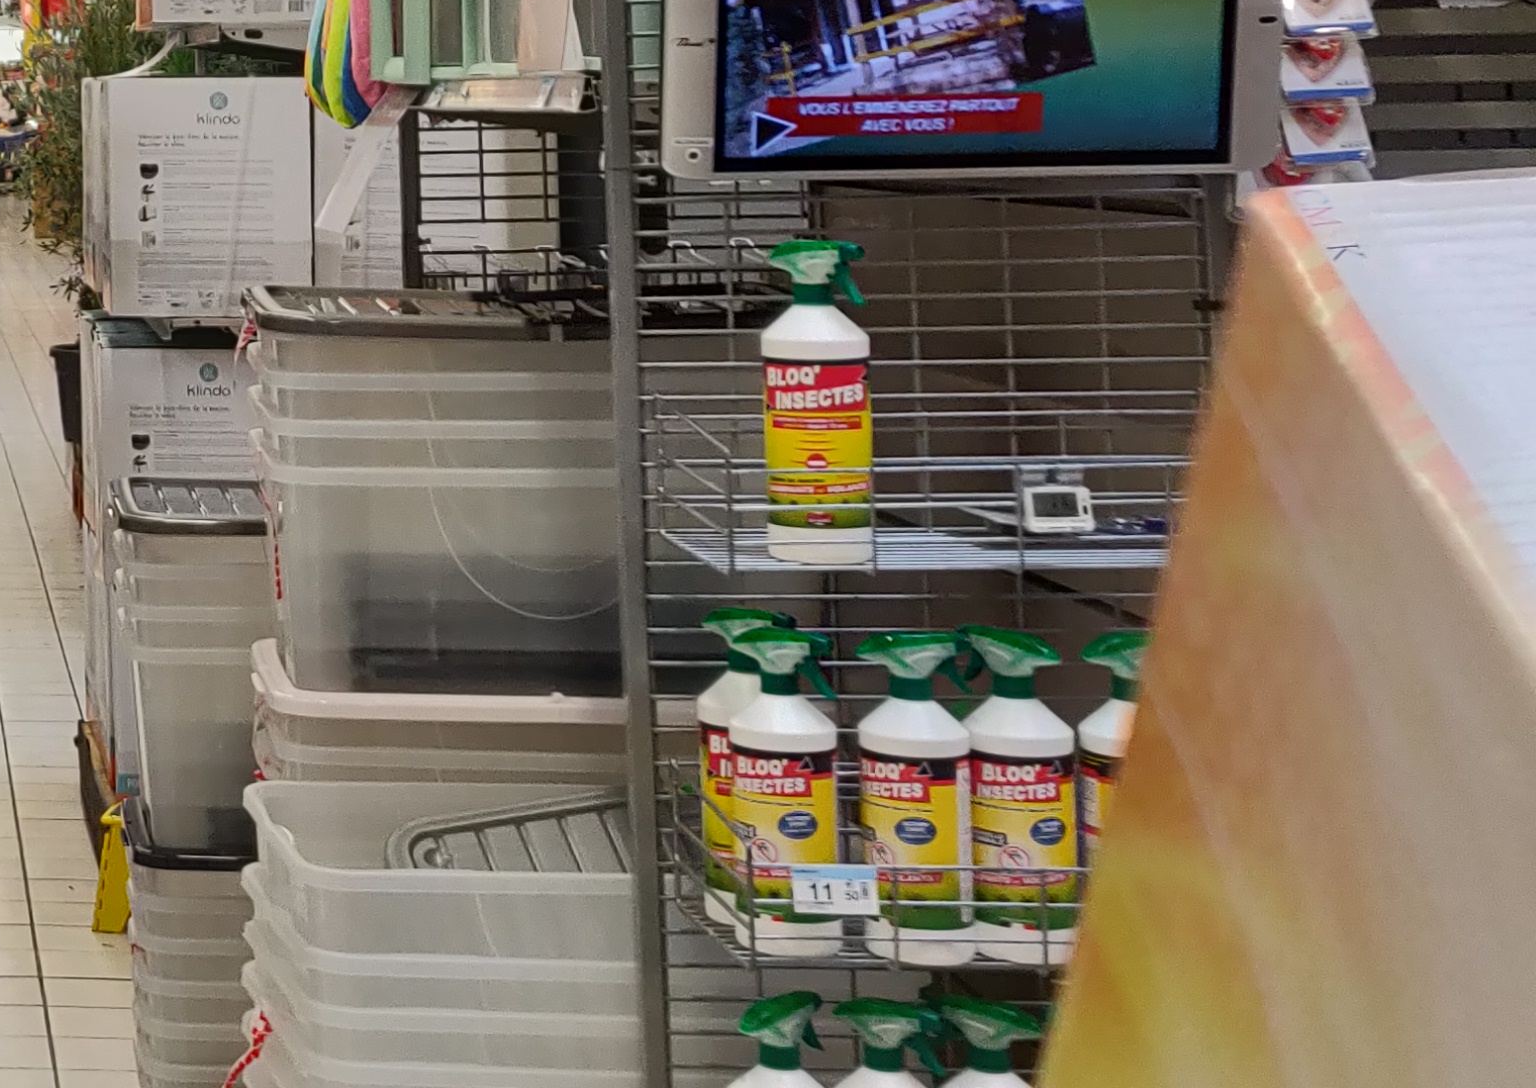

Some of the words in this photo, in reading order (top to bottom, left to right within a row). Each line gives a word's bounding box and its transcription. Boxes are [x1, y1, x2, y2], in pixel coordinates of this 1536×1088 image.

[196, 112, 241, 126] klindo
[904, 118, 945, 132] VOUS
[766, 365, 821, 387] BLOQ'
[186, 384, 231, 397] klindo
[775, 383, 864, 410] INSECTES
[736, 757, 789, 777] BLOQ'
[981, 763, 1040, 783] BLOQ'
[976, 781, 1057, 801] INSECTES
[809, 882, 832, 901] 11
